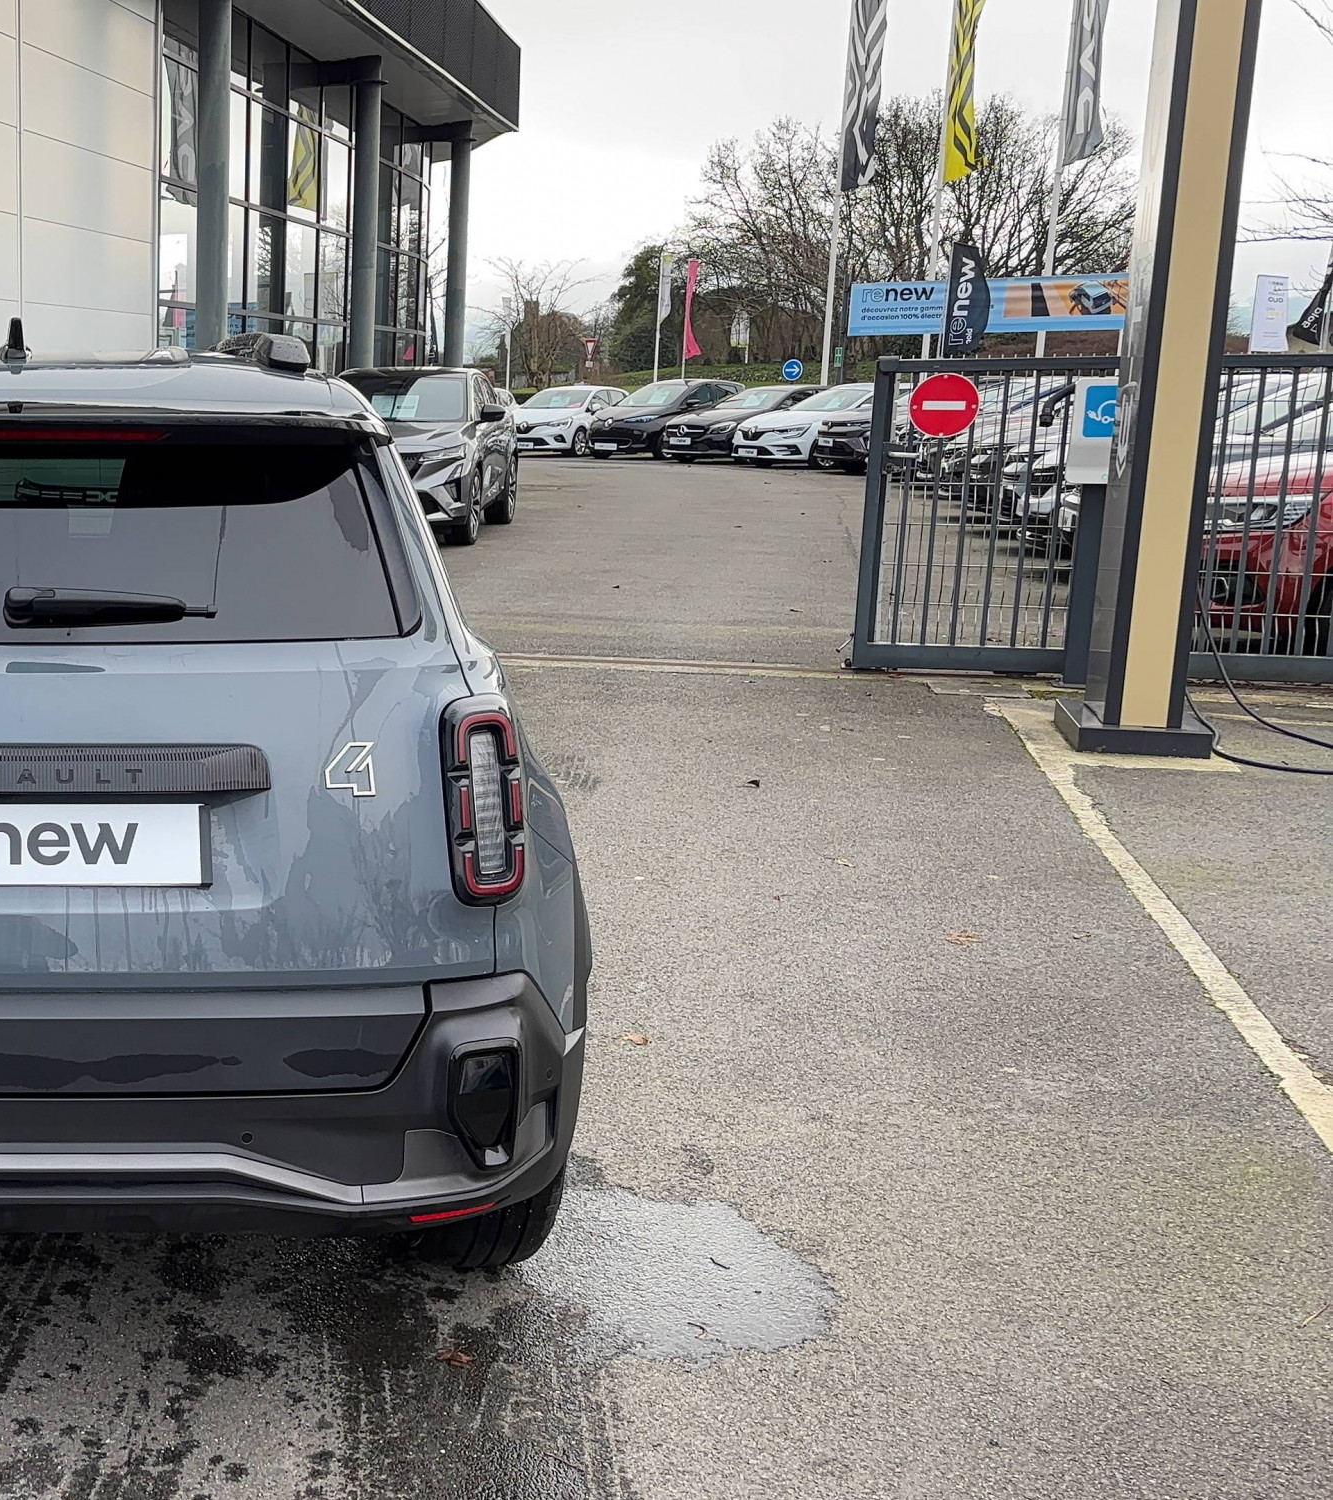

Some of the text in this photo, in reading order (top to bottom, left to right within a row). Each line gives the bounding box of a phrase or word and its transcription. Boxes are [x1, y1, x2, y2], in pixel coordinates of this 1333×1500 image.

[862, 286, 935, 303] renew
[948, 257, 976, 345] renew
[920, 305, 943, 313] gamm
